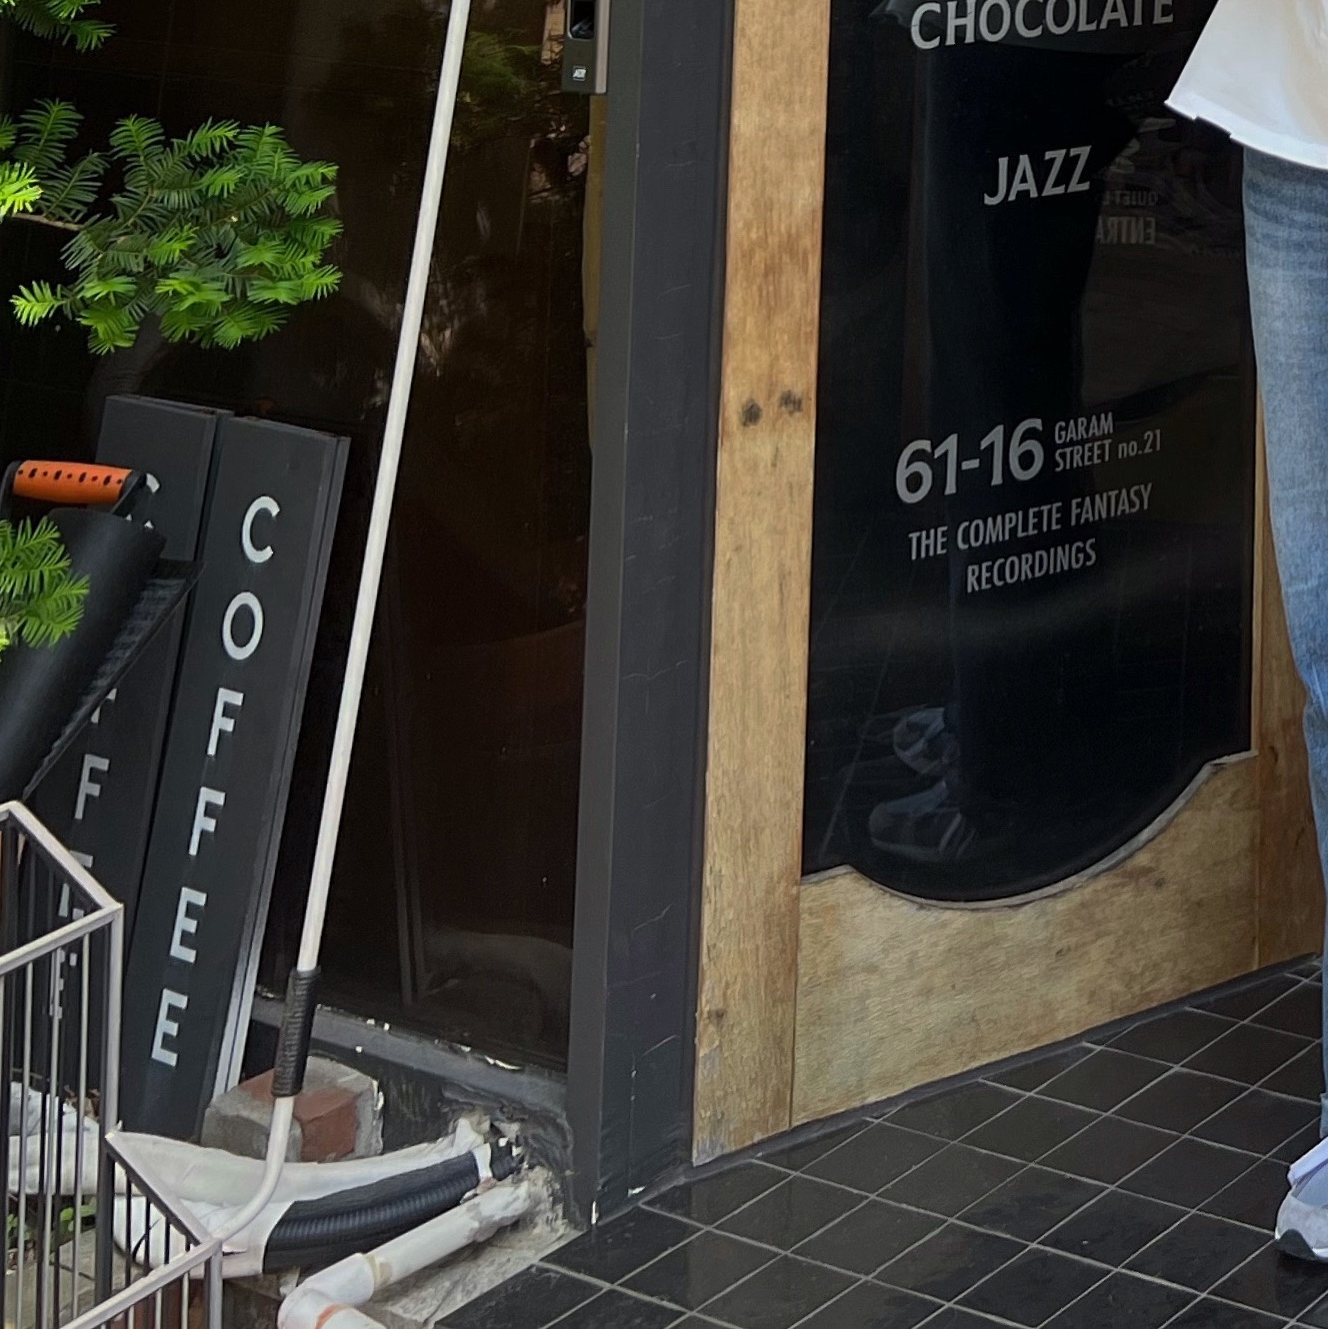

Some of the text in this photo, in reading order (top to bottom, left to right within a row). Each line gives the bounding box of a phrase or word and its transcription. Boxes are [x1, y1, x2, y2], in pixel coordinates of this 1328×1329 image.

[984, 146, 1092, 205] JAZZ
[1054, 411, 1114, 445] GARAM
[1054, 428, 1162, 471] STREET no.21
[895, 417, 1045, 504] 61-16
[908, 482, 1152, 561] THE COMPLETE FANTASY
[966, 537, 1096, 594] RECORDINGS
[150, 494, 281, 1068] COFFEE
